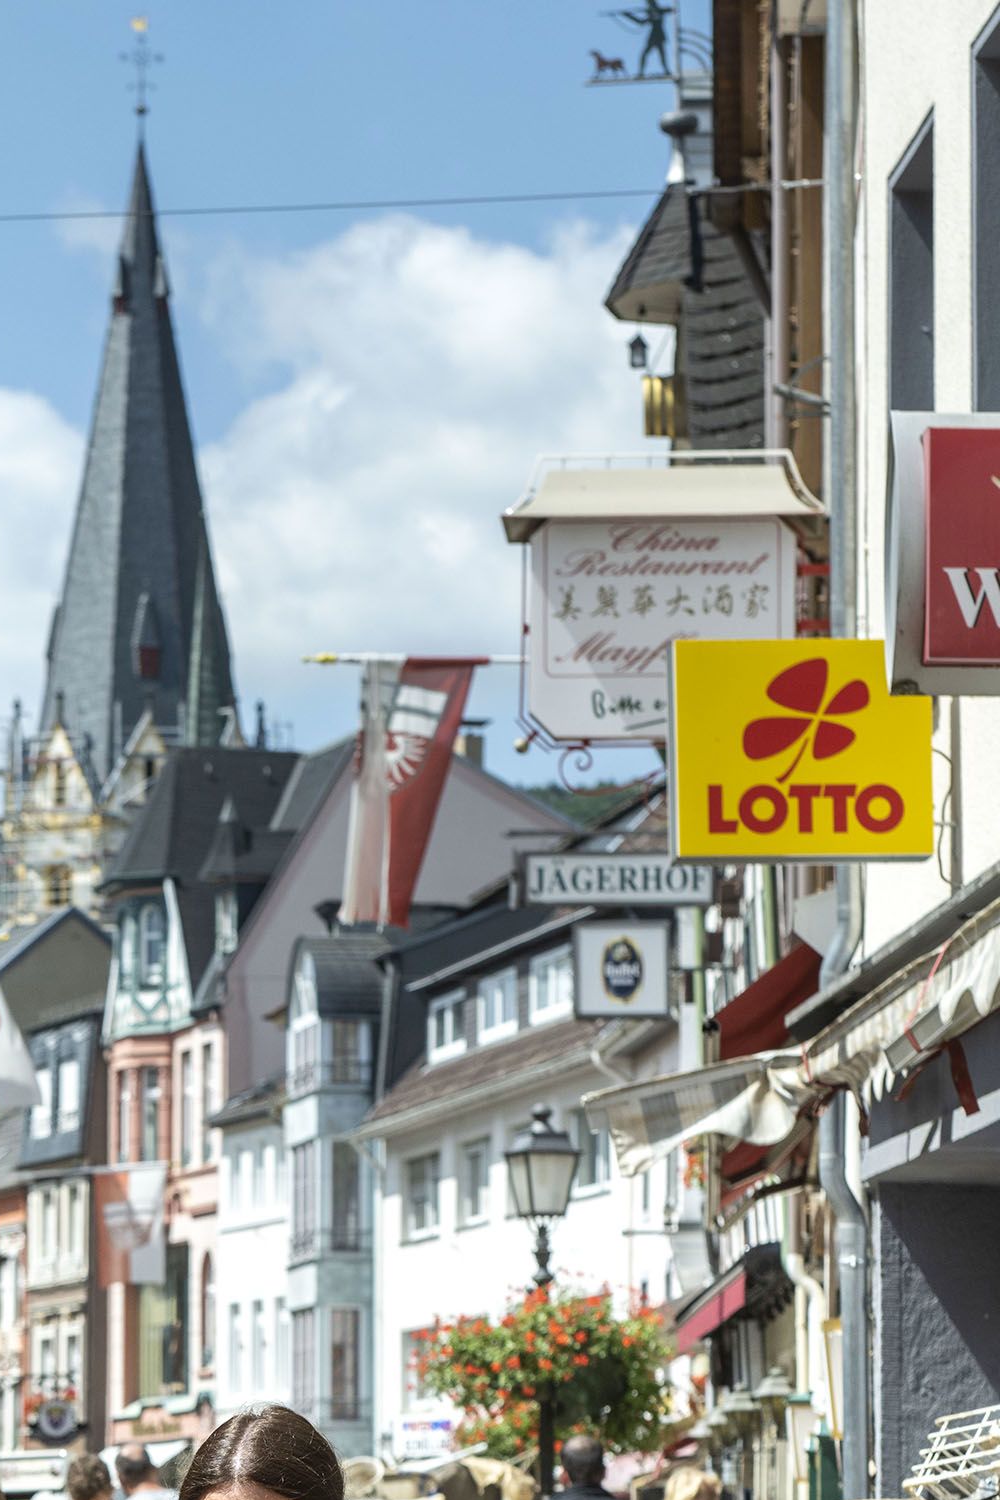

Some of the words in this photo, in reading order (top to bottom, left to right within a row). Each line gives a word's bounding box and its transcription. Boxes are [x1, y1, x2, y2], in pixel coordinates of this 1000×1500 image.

[609, 524, 720, 552] China
[554, 551, 770, 578] Restaurant
[707, 783, 905, 835] LOTTO
[530, 857, 707, 897] JÄGERHOF
